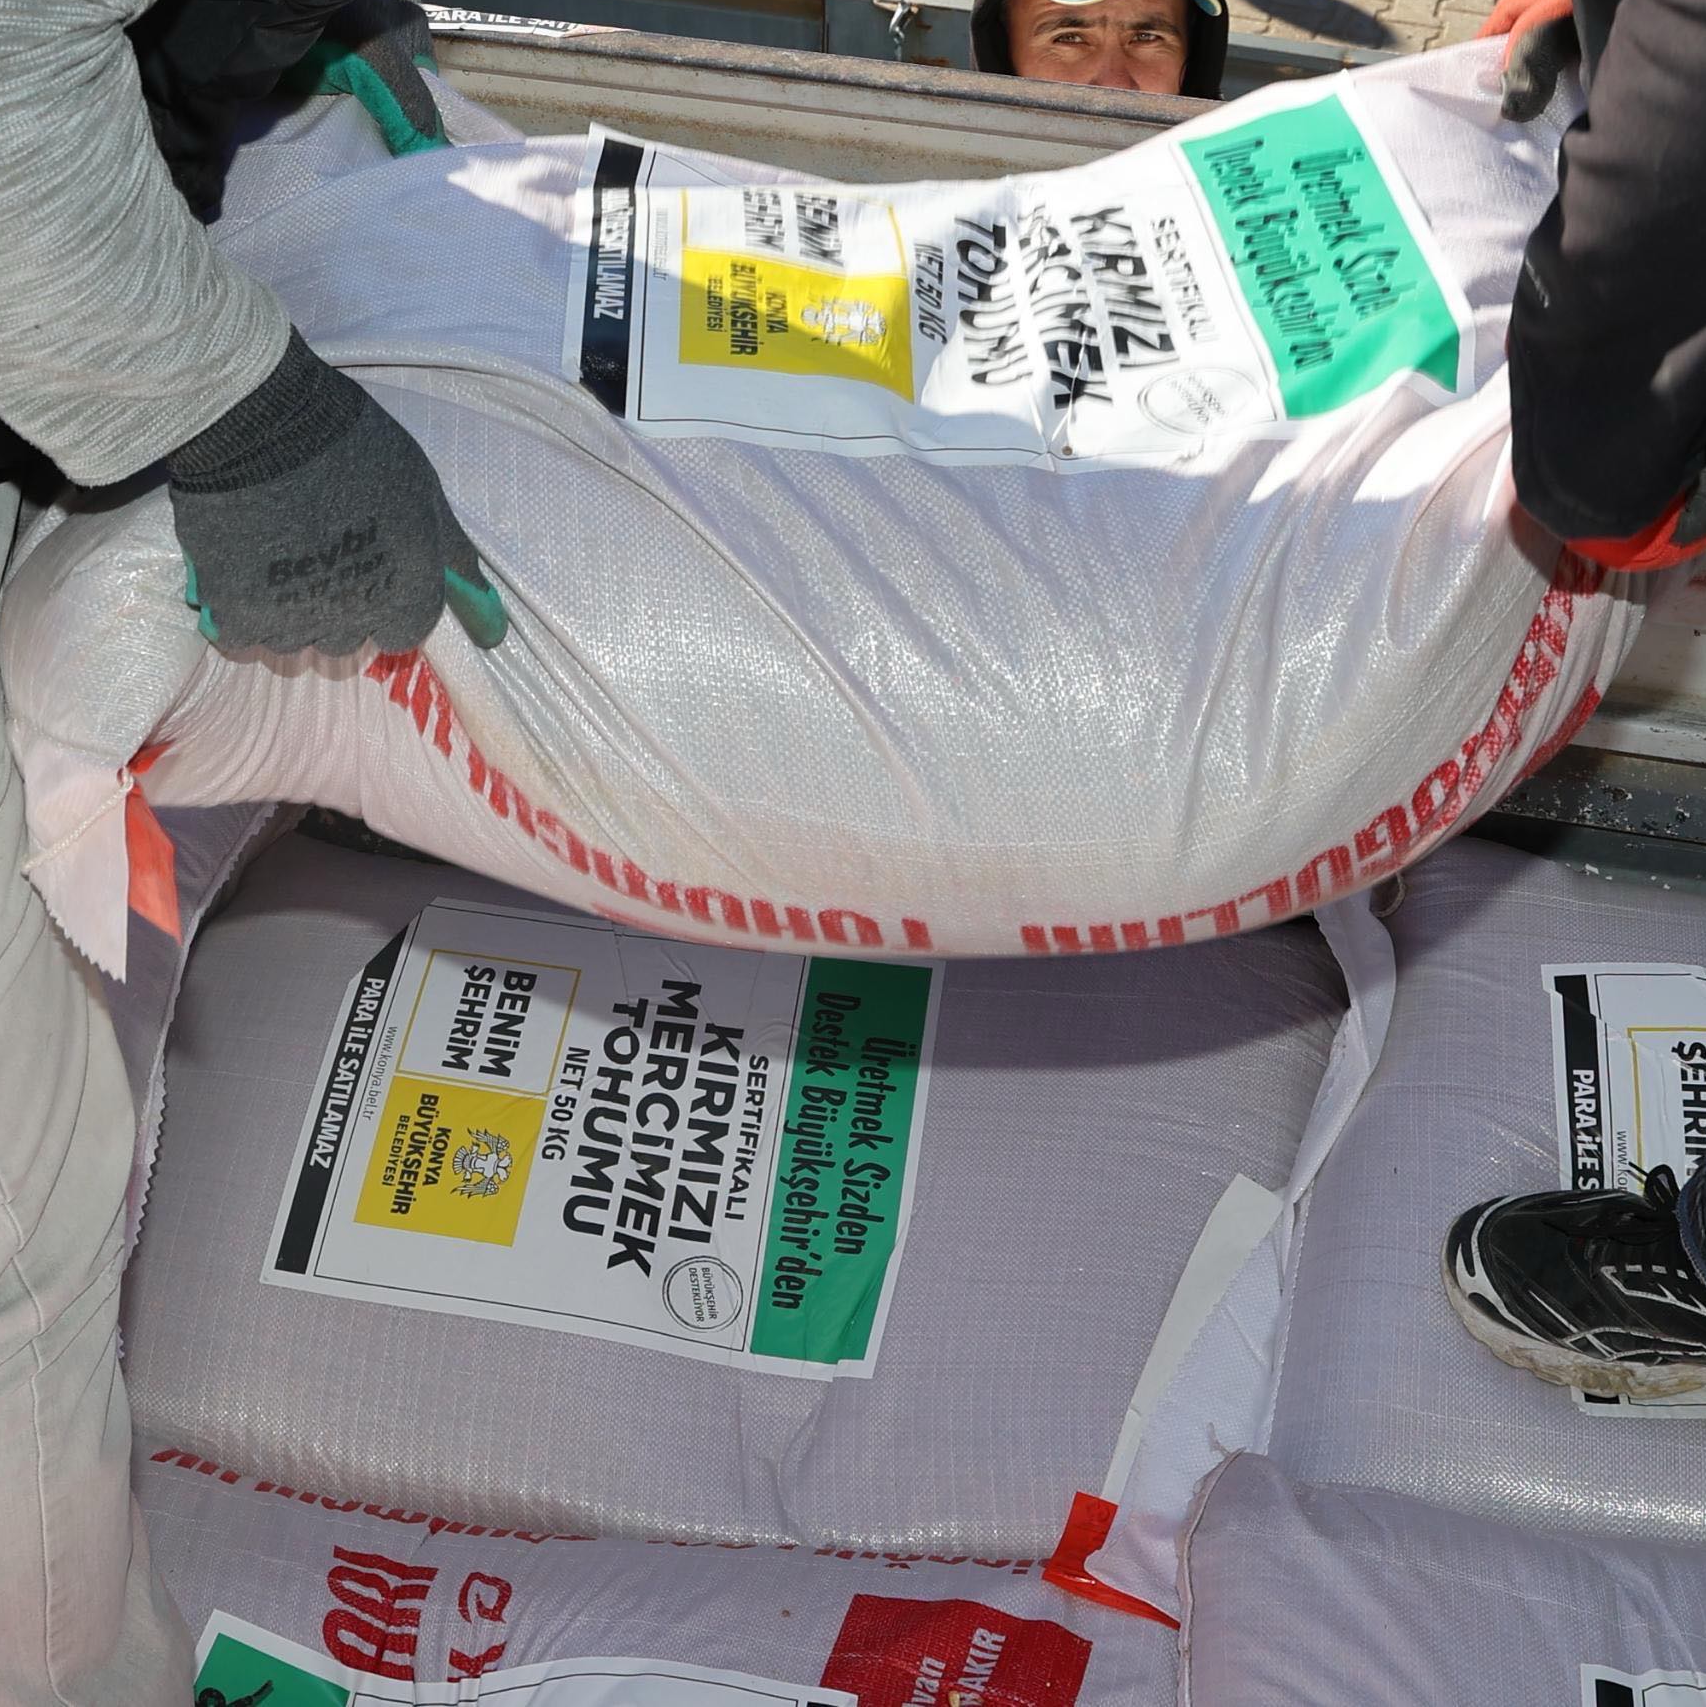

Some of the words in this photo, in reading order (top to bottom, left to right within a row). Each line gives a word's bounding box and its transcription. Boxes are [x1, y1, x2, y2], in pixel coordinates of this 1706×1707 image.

[342, 1022, 374, 1057] İLE
[352, 976, 387, 1023] PARA
[441, 963, 497, 1072] ŞEHRİM
[478, 969, 538, 1079] BENİM
[804, 991, 862, 1078] Destek
[309, 1056, 360, 1171] SATILAMAZ
[362, 1025, 399, 1122] www.konya.bel.tr
[549, 1093, 578, 1124] 50
[565, 1045, 592, 1092] NET
[847, 1035, 917, 1151] Üretmek
[1572, 1069, 1596, 1130] PARA
[381, 1113, 411, 1188] BELEDİYESİ
[390, 1092, 440, 1216] BÜYÜKŞEHİR
[421, 1126, 453, 1187] KONYA
[540, 1124, 571, 1163] KG
[562, 997, 649, 1238] TOHUMU
[606, 978, 704, 1281] MERCİMEK
[666, 1022, 746, 1245] KIRMIZI
[723, 1052, 770, 1223] SERTİFİKALI
[771, 1084, 848, 1311] Büyükşehir'den
[834, 1156, 892, 1256] Sizden
[687, 1265, 705, 1324] DESTEKLİYOR
[699, 1265, 719, 1322] BÜYÜKŞEHİR
